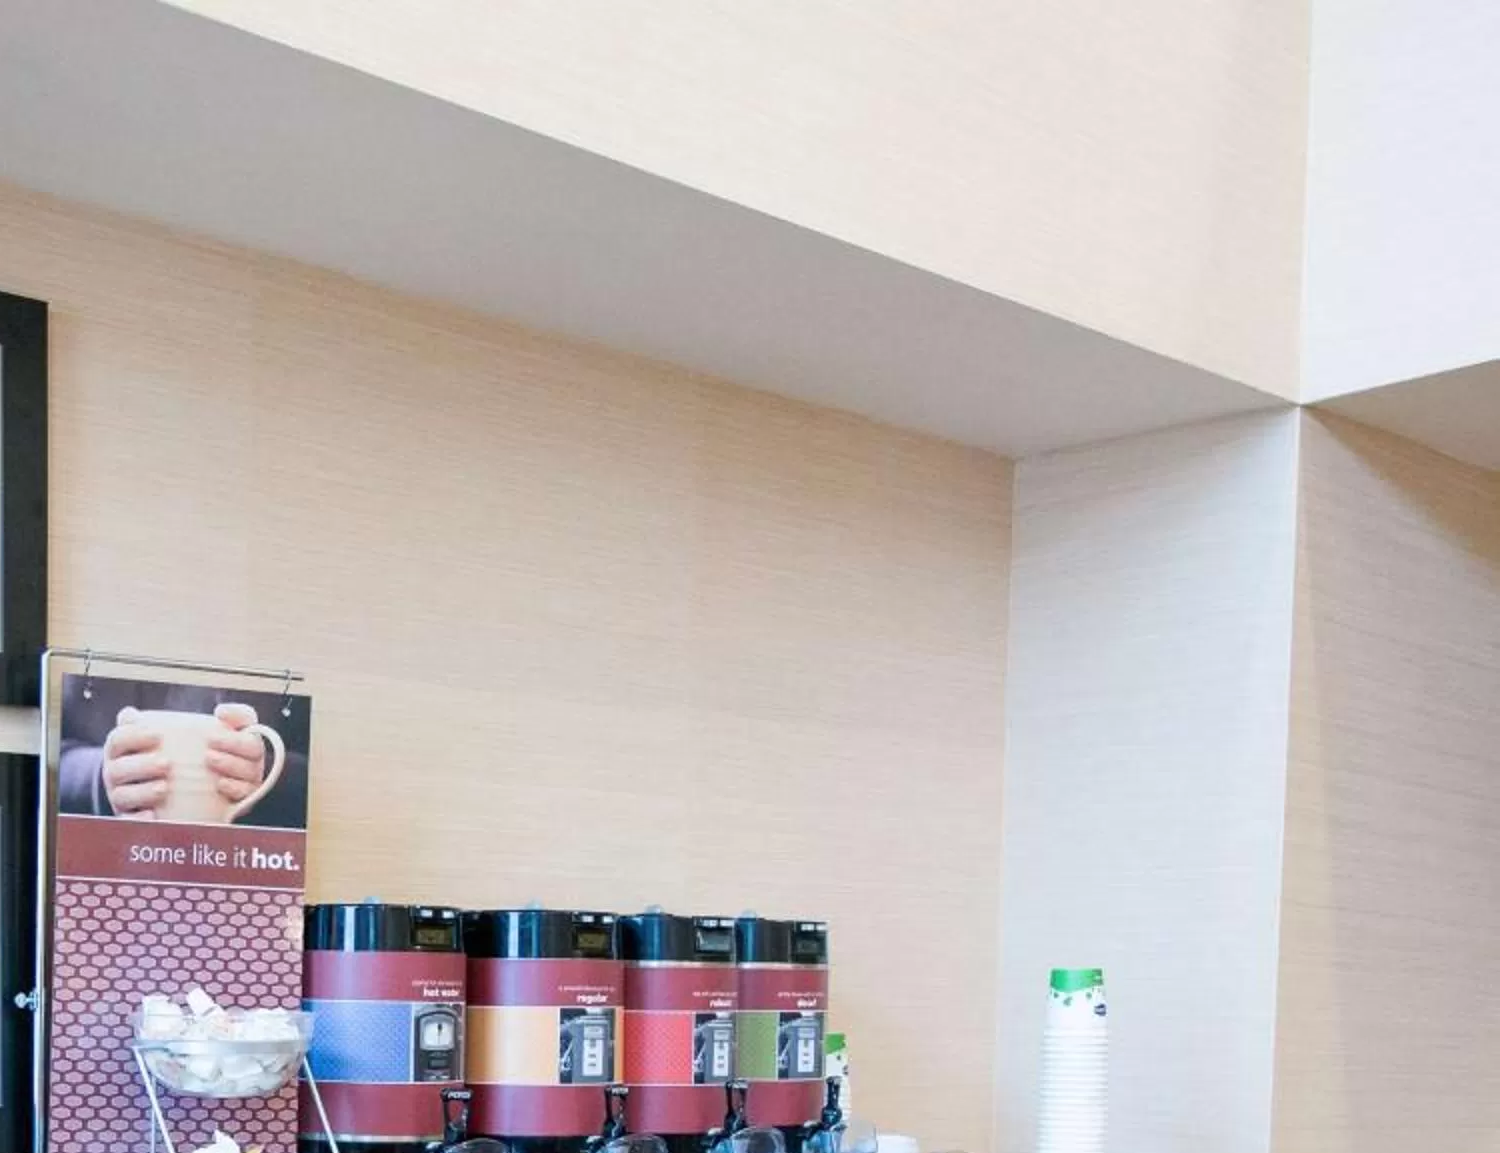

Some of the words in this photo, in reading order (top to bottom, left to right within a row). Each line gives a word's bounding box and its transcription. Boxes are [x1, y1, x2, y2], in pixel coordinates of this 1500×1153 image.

[129, 844, 186, 865] some
[192, 843, 227, 867] like
[233, 846, 250, 869] it
[251, 847, 301, 871] hot.
